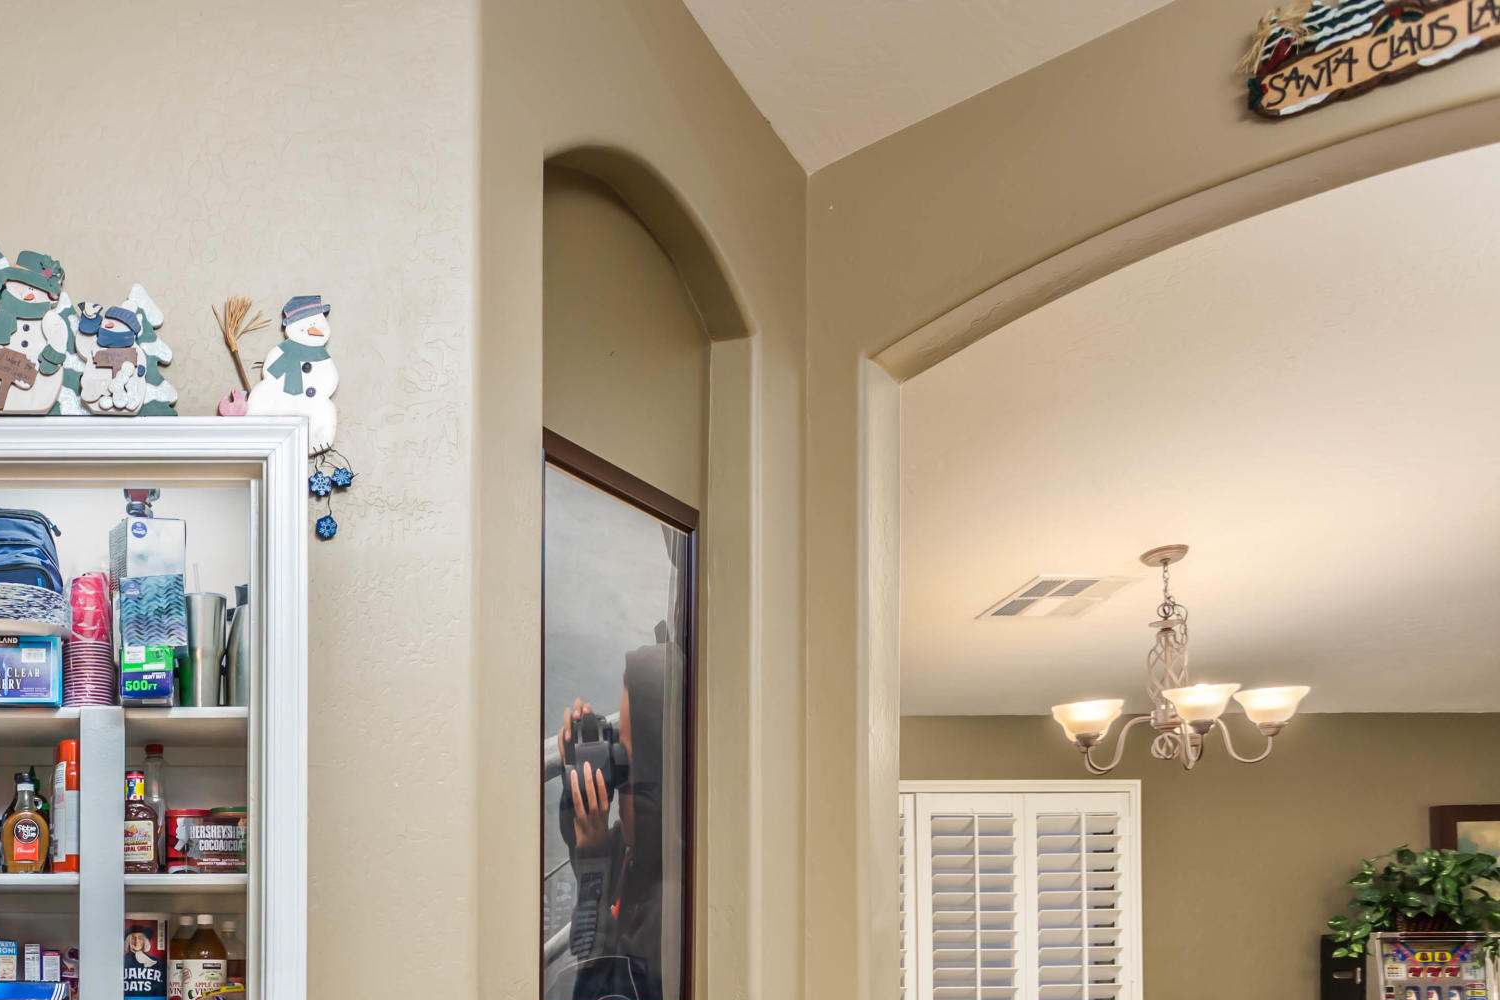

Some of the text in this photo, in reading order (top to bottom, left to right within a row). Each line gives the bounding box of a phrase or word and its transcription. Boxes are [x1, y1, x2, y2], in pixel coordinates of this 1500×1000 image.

[1266, 0, 1500, 107] SANTA CLAUS LA
[7, 667, 40, 677] CLEAR
[124, 968, 161, 982] UAKER
